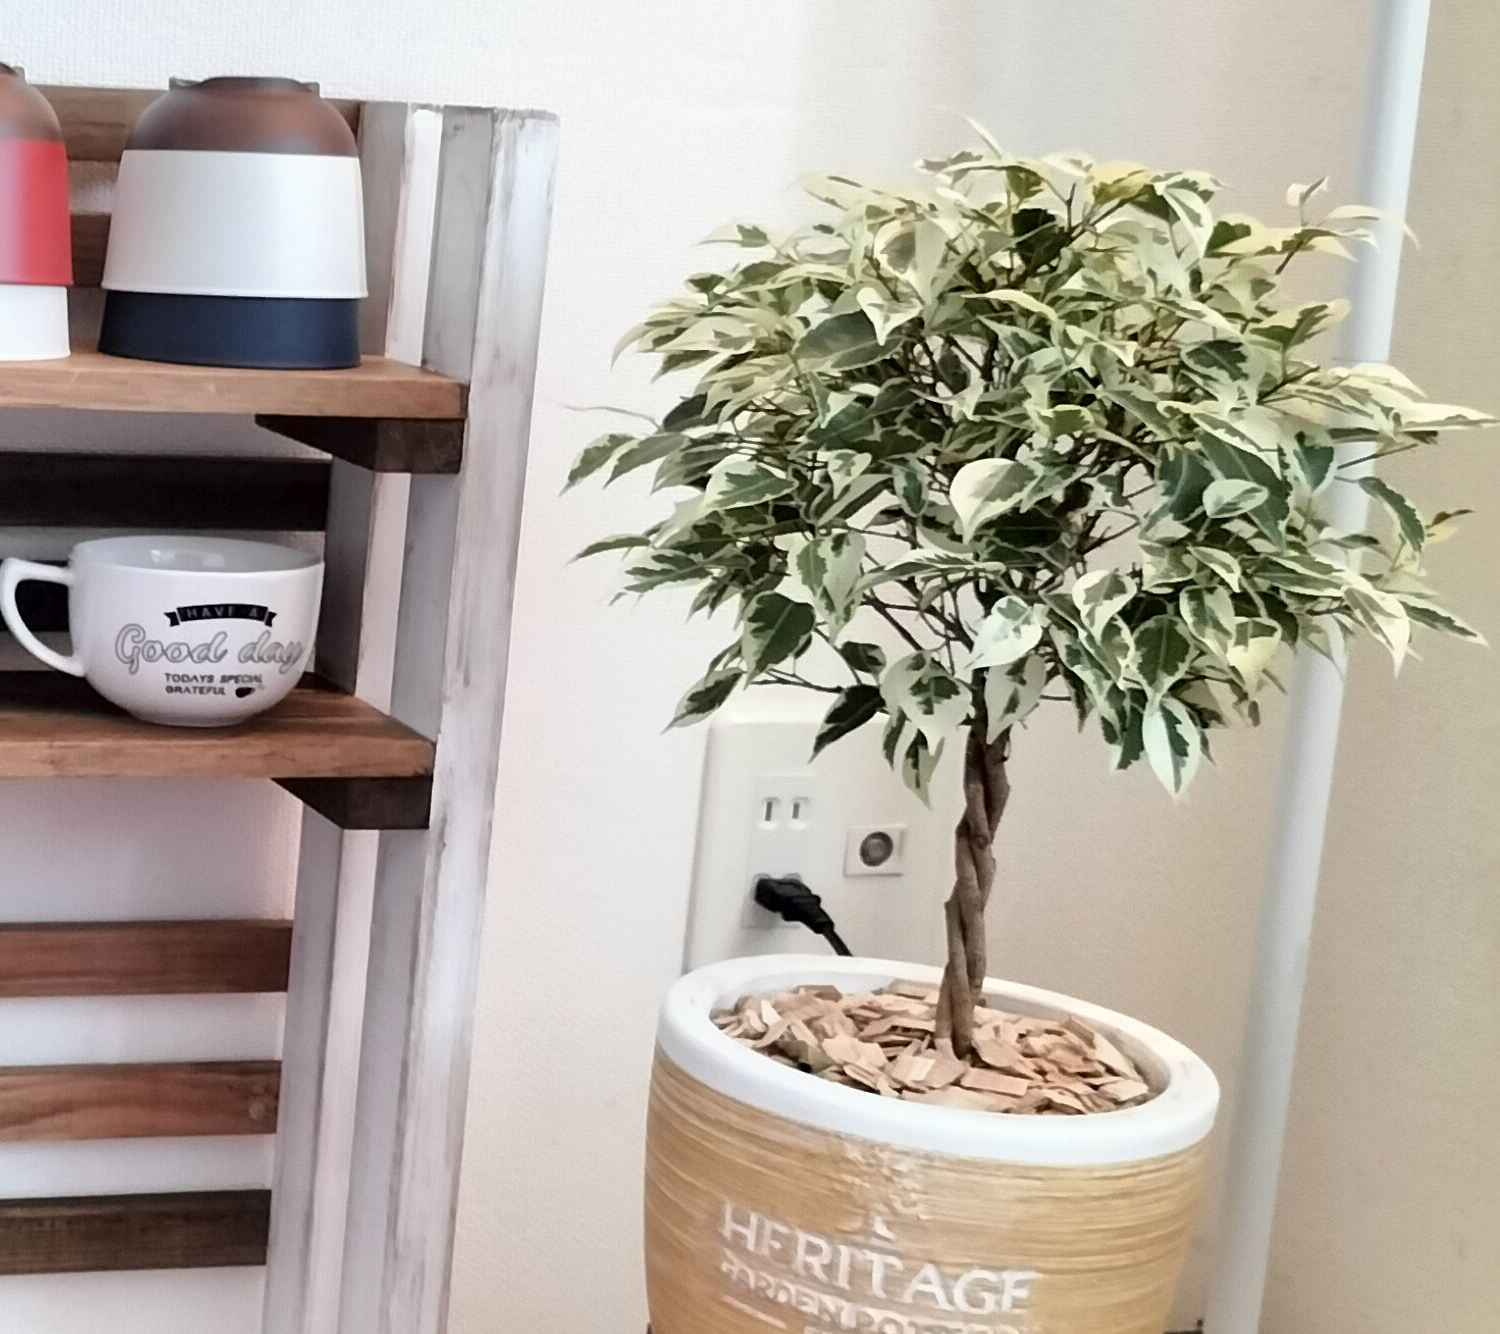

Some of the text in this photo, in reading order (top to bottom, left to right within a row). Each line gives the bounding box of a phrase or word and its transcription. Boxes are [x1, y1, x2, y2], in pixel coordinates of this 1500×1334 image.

[114, 623, 305, 676] Good day
[164, 672, 214, 684] TODAYS
[165, 685, 226, 696] GRATEFUL
[721, 1199, 1041, 1315] HERITAGE
